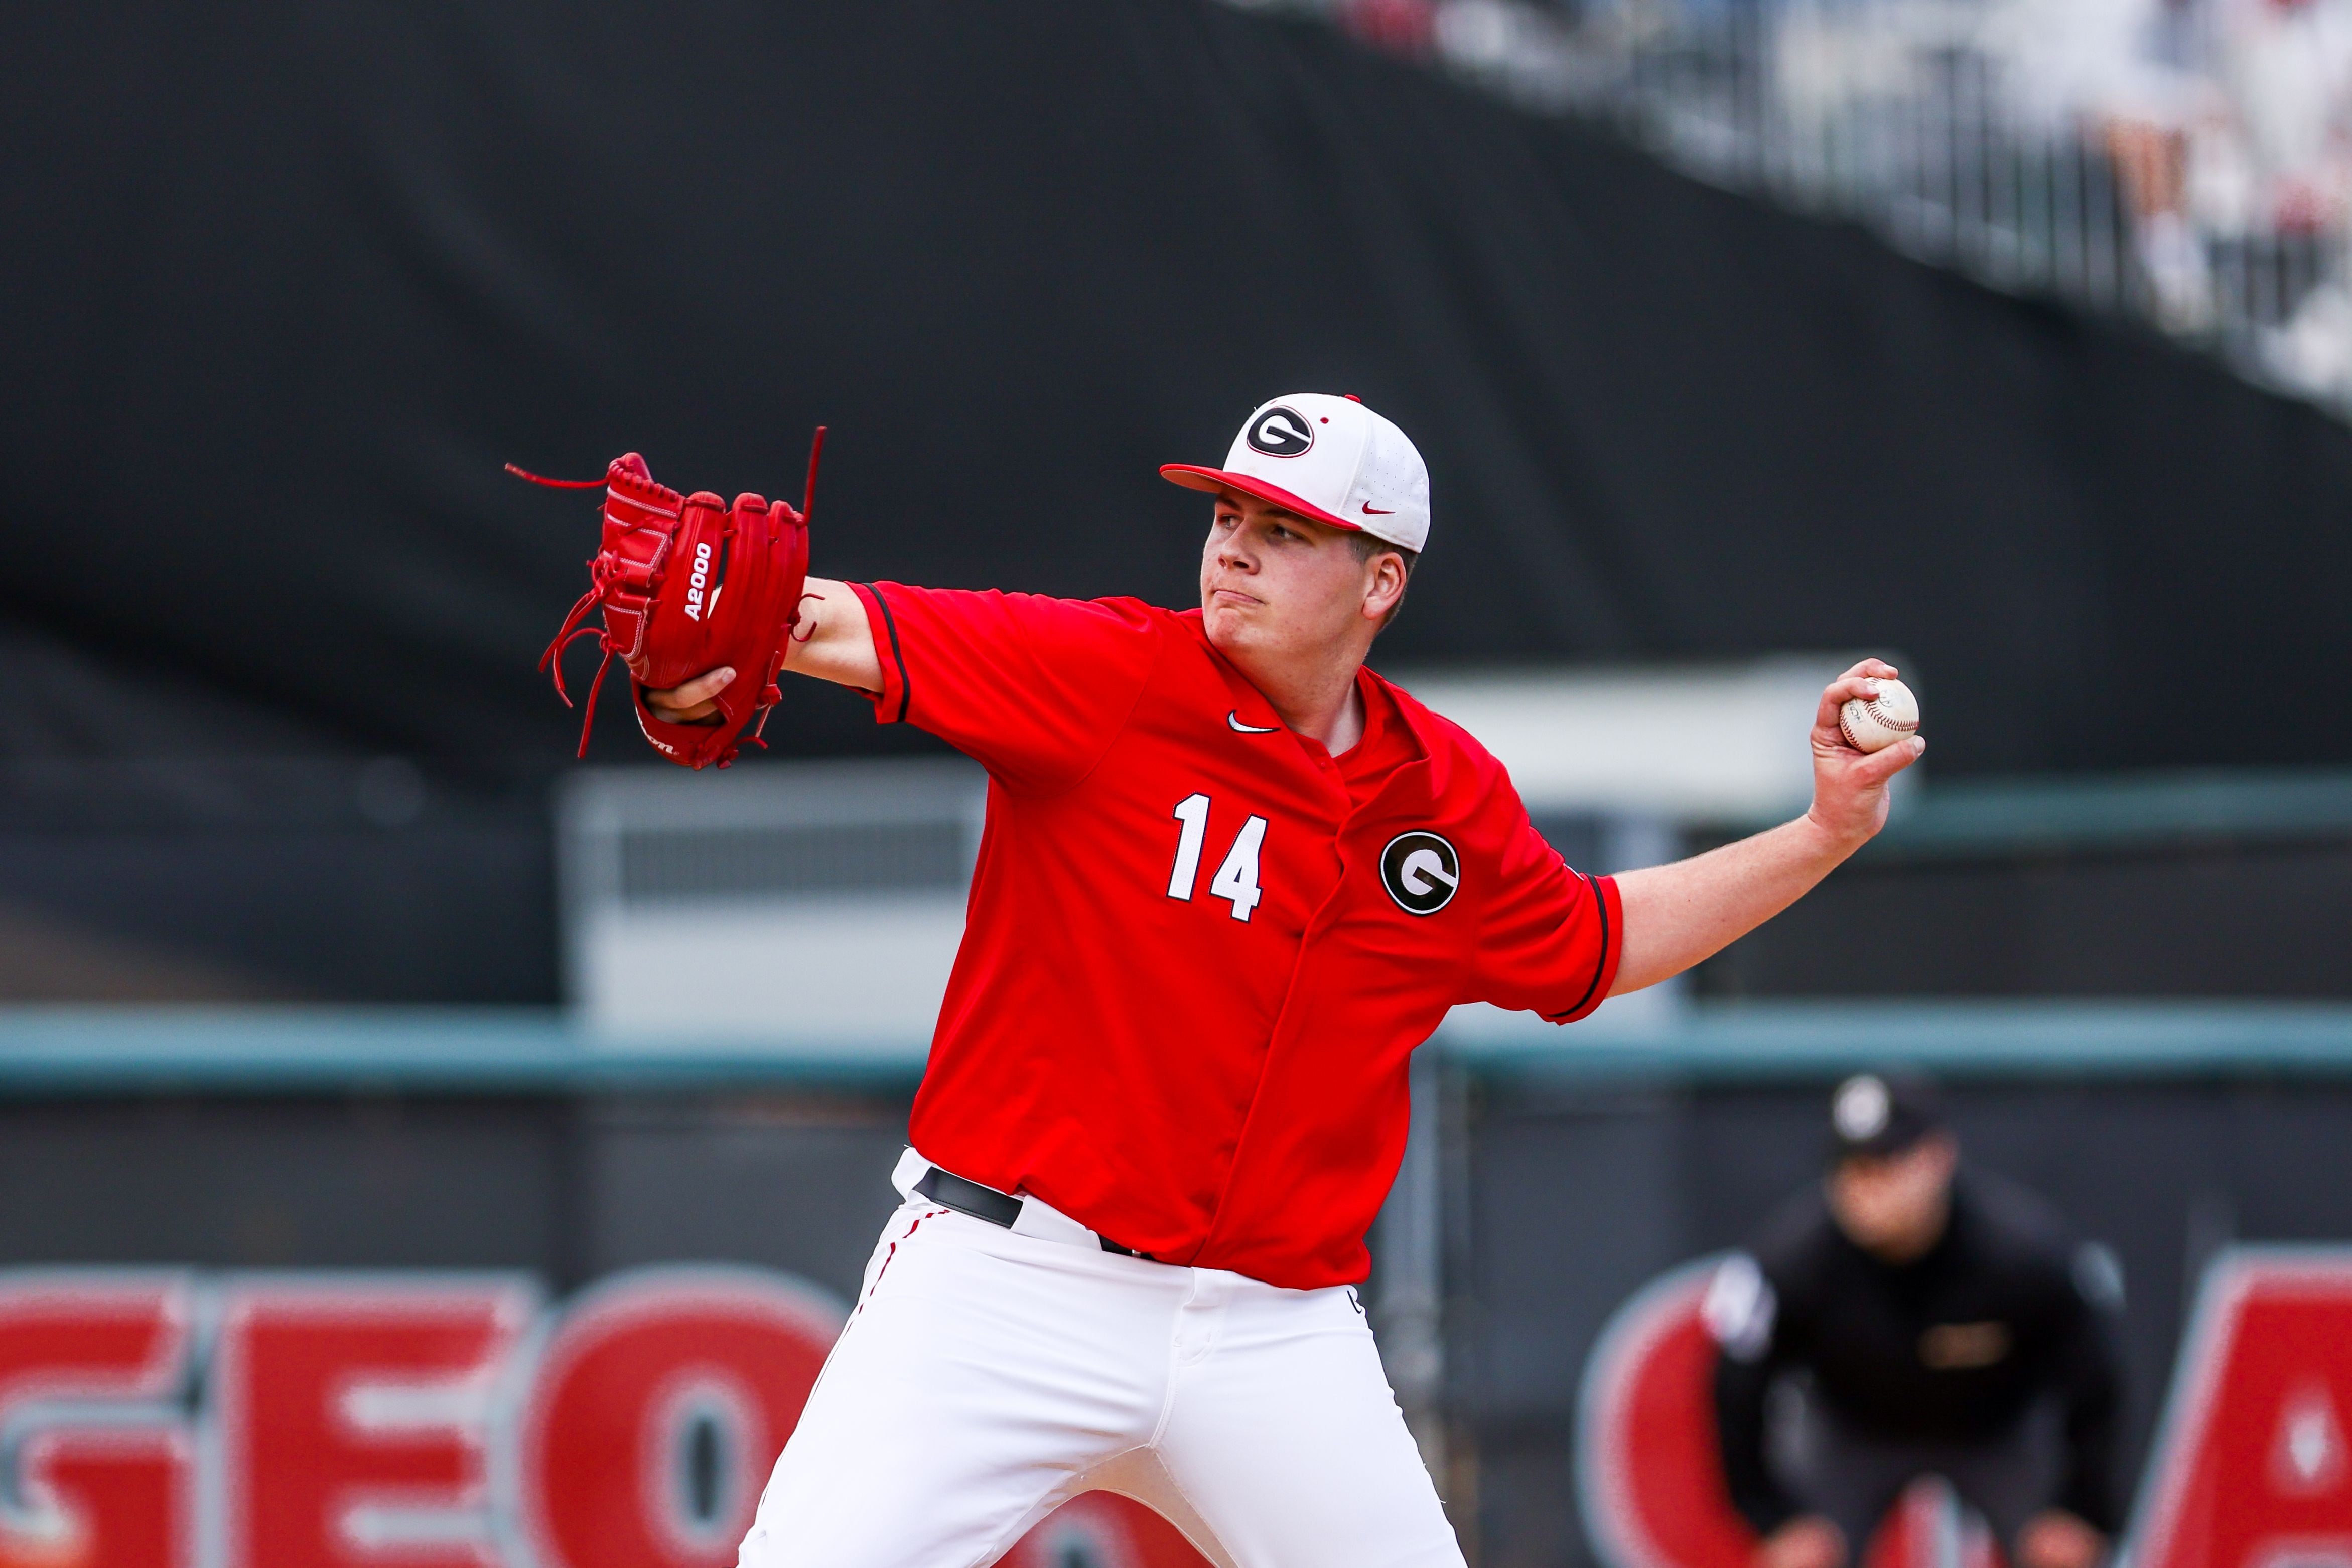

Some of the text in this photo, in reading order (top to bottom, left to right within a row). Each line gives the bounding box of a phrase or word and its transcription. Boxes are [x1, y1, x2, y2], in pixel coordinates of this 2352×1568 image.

[1247, 406, 1314, 457] G
[684, 542, 711, 622] A2000
[1165, 791, 1269, 924] 14
[1380, 830, 1459, 916] G
